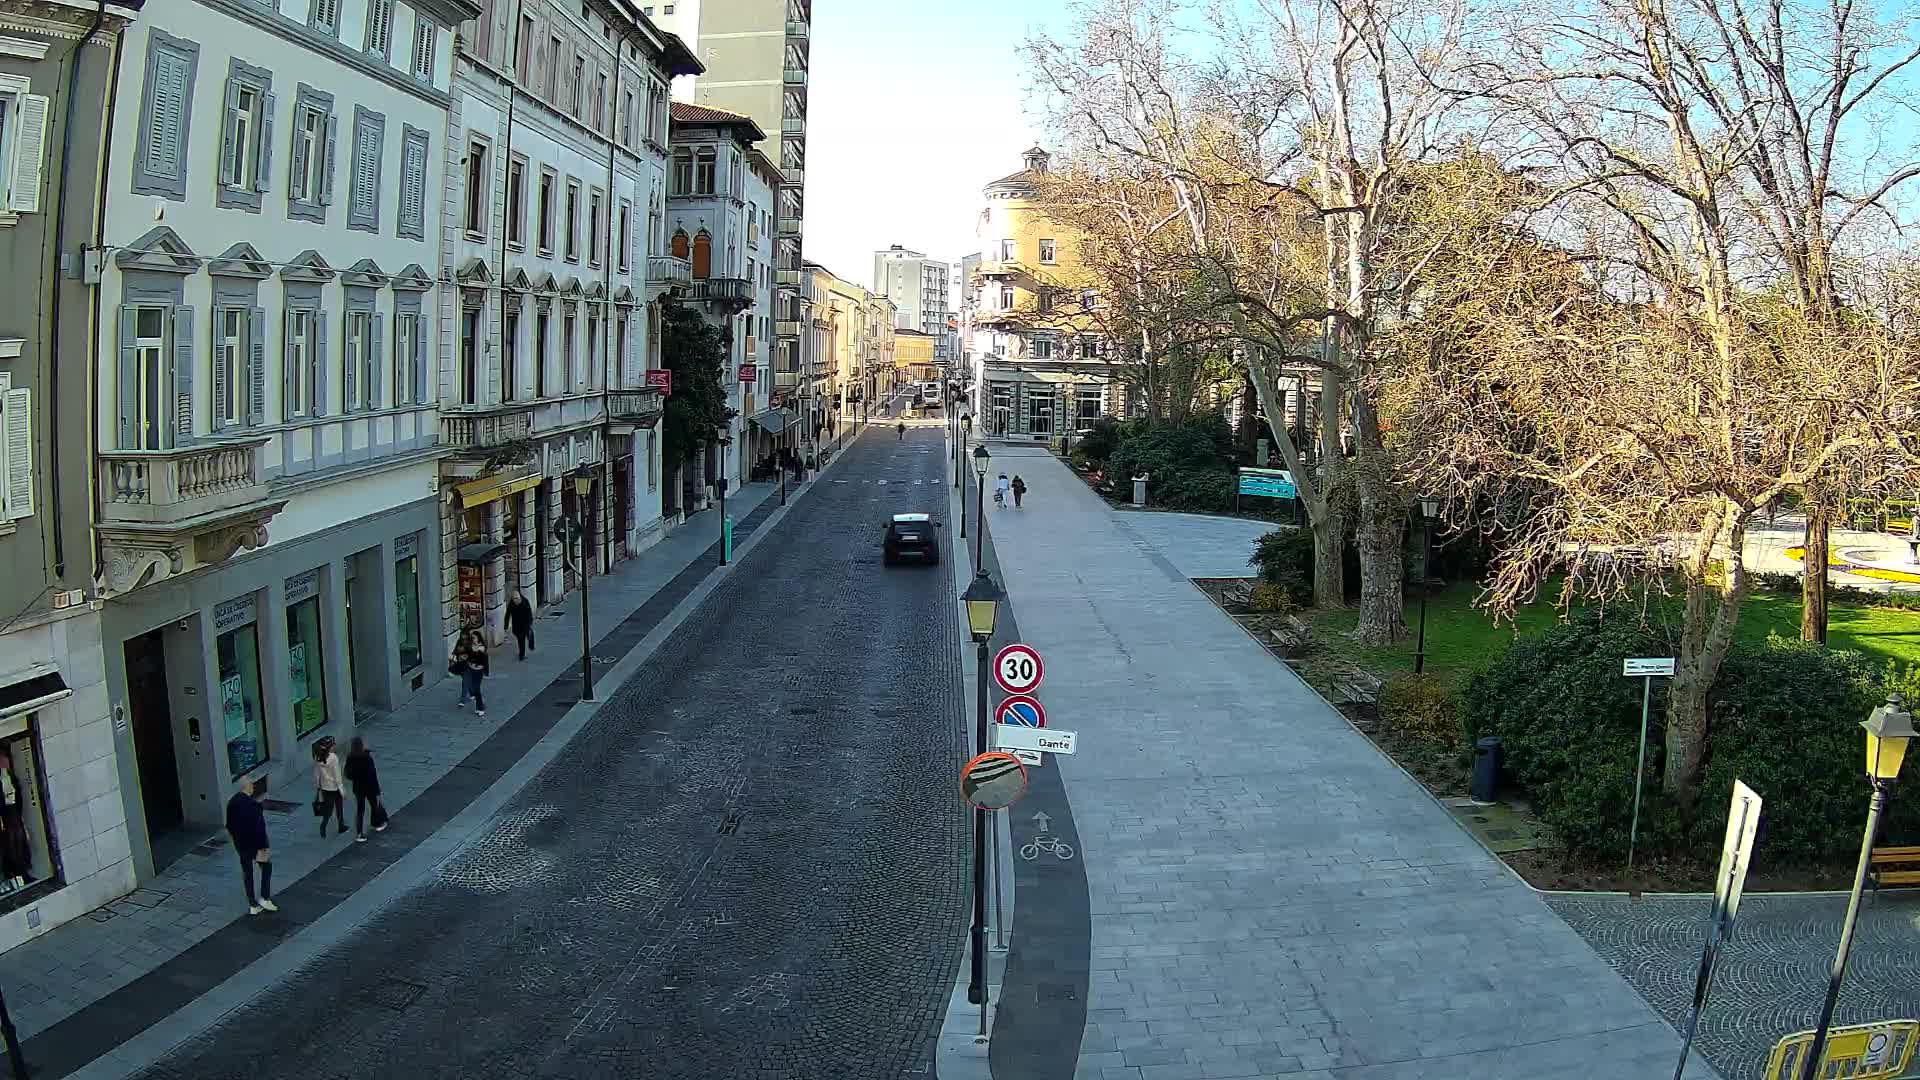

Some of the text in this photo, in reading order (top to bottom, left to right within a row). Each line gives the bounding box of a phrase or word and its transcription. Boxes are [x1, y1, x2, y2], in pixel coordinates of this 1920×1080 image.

[1006, 658, 1033, 680] 30
[223, 677, 240, 700] 130
[1038, 738, 1070, 749] Dante
